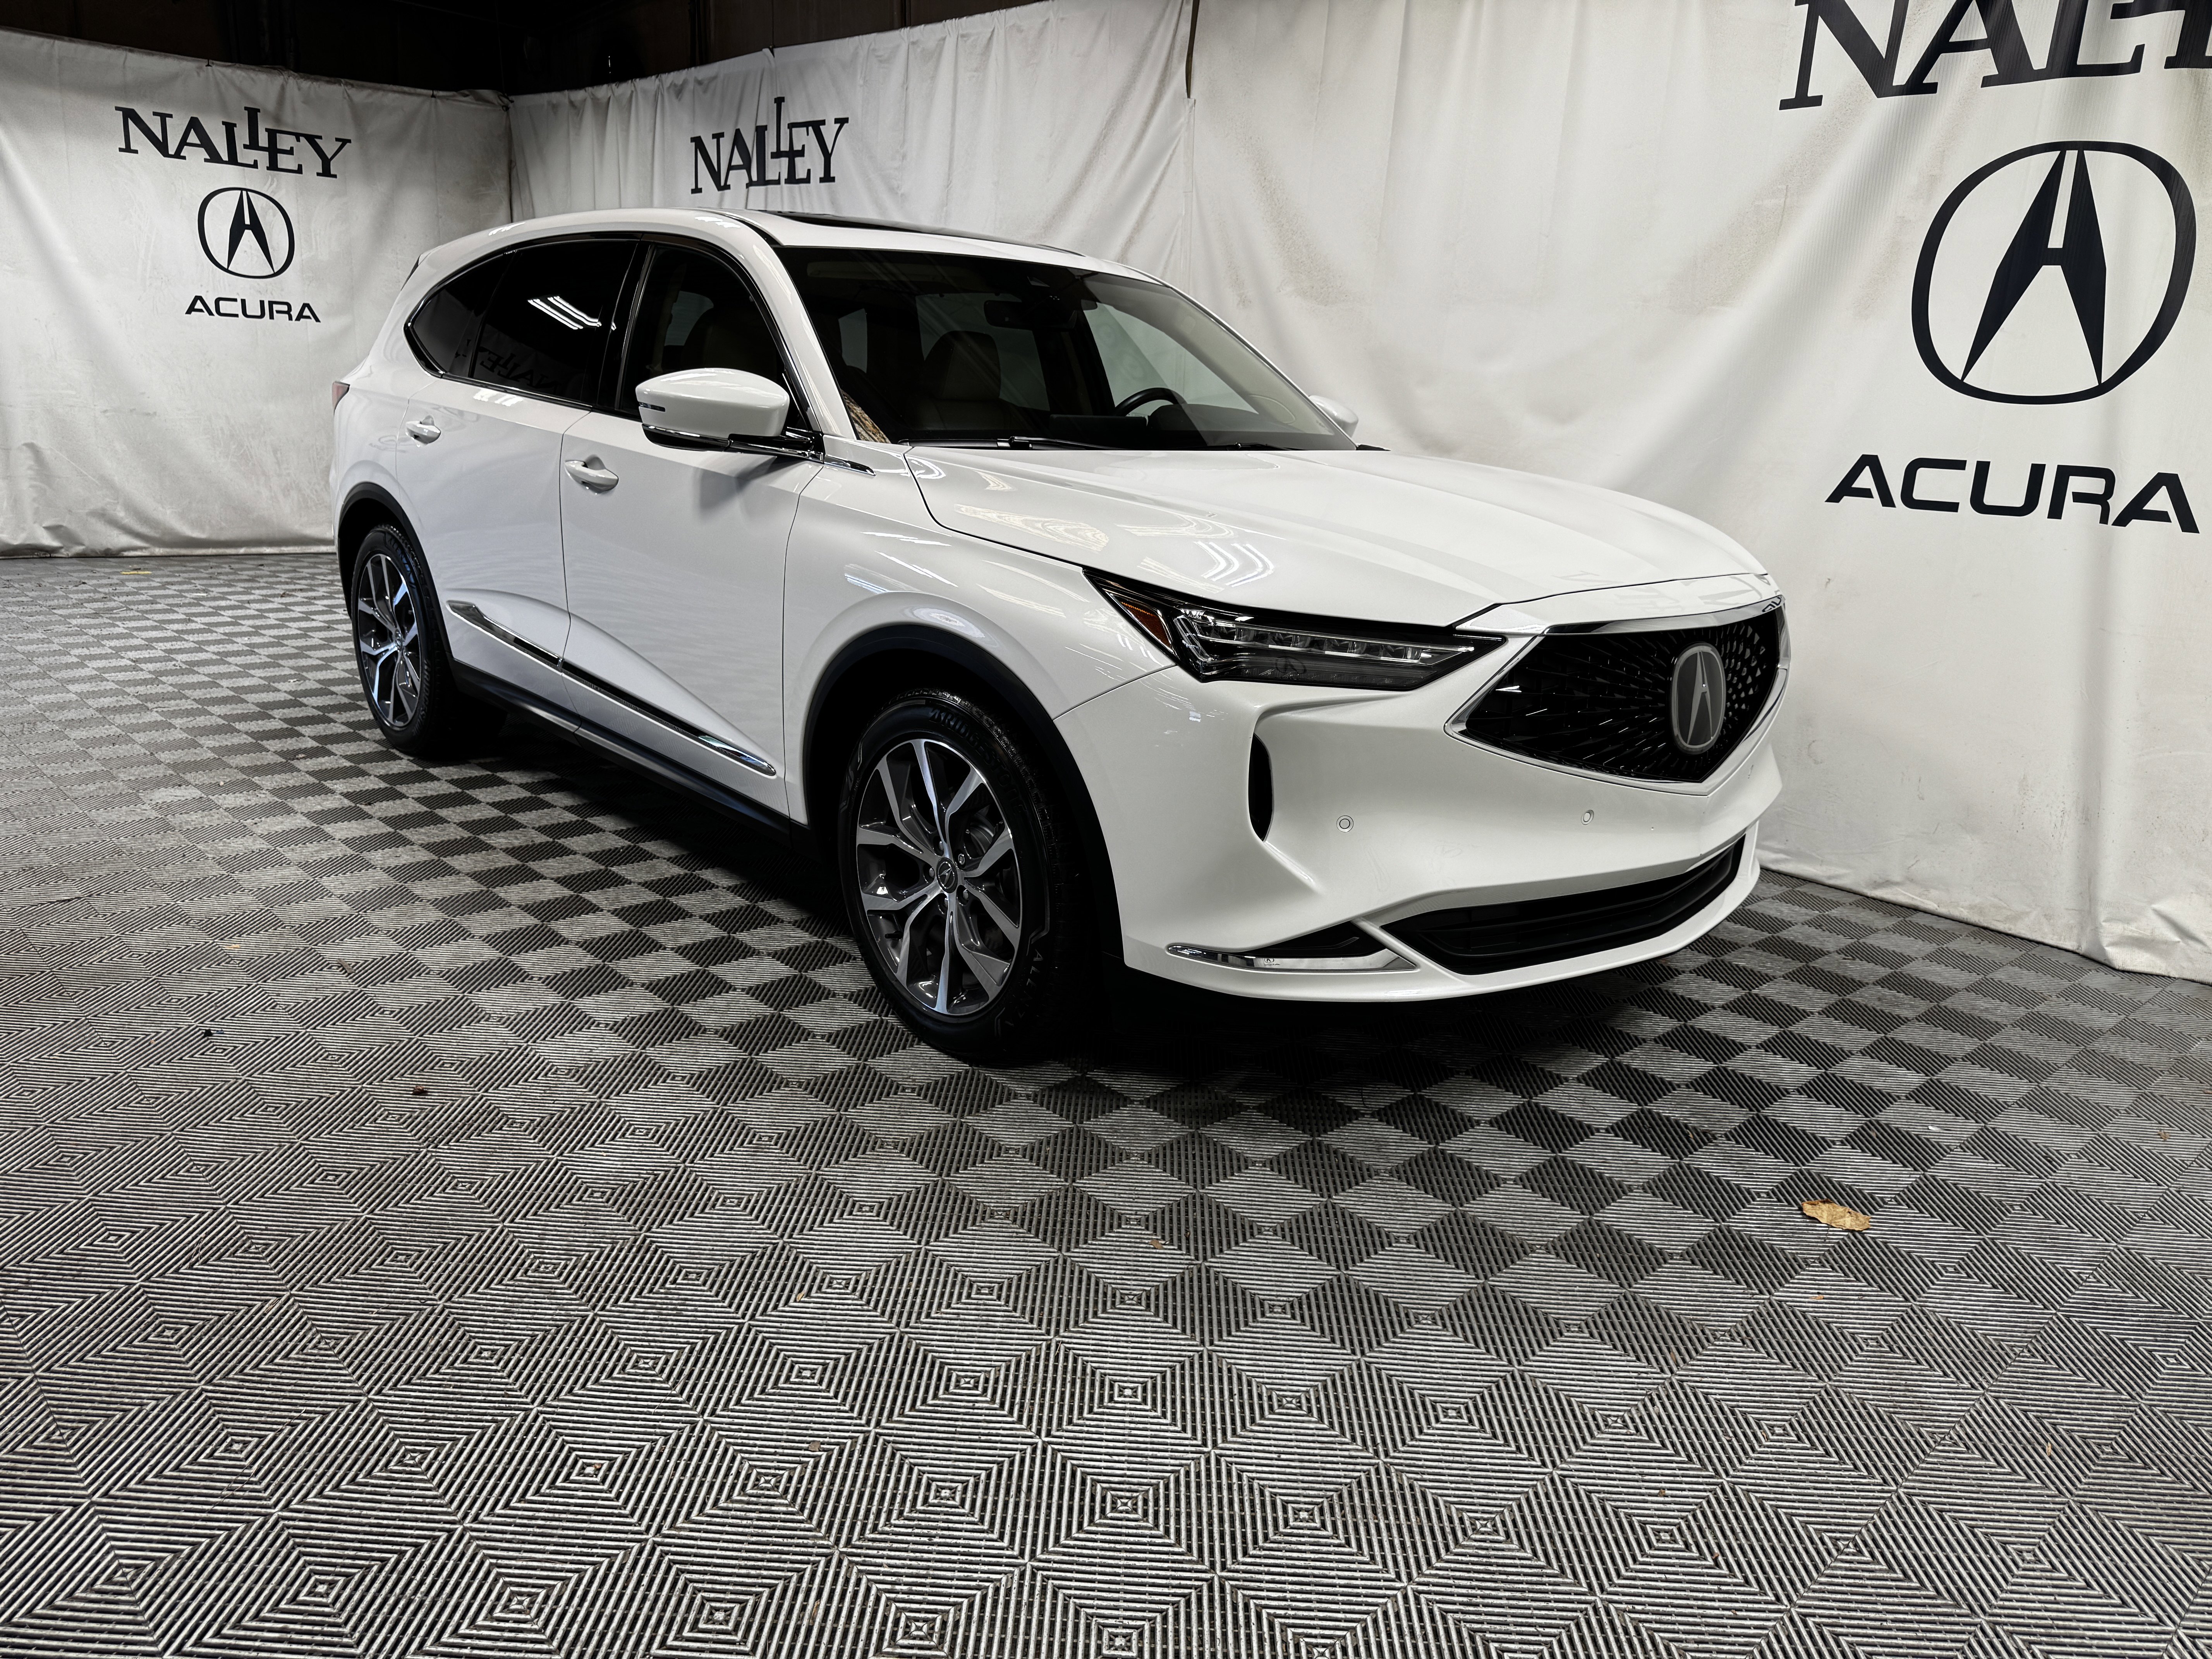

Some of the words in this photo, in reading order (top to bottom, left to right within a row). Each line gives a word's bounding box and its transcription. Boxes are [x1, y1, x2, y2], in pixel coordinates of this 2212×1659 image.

[115, 106, 352, 179] NALLEY
[690, 96, 849, 194] NALLEY
[185, 295, 321, 323] ACURA
[1824, 454, 2200, 534] ACURA
